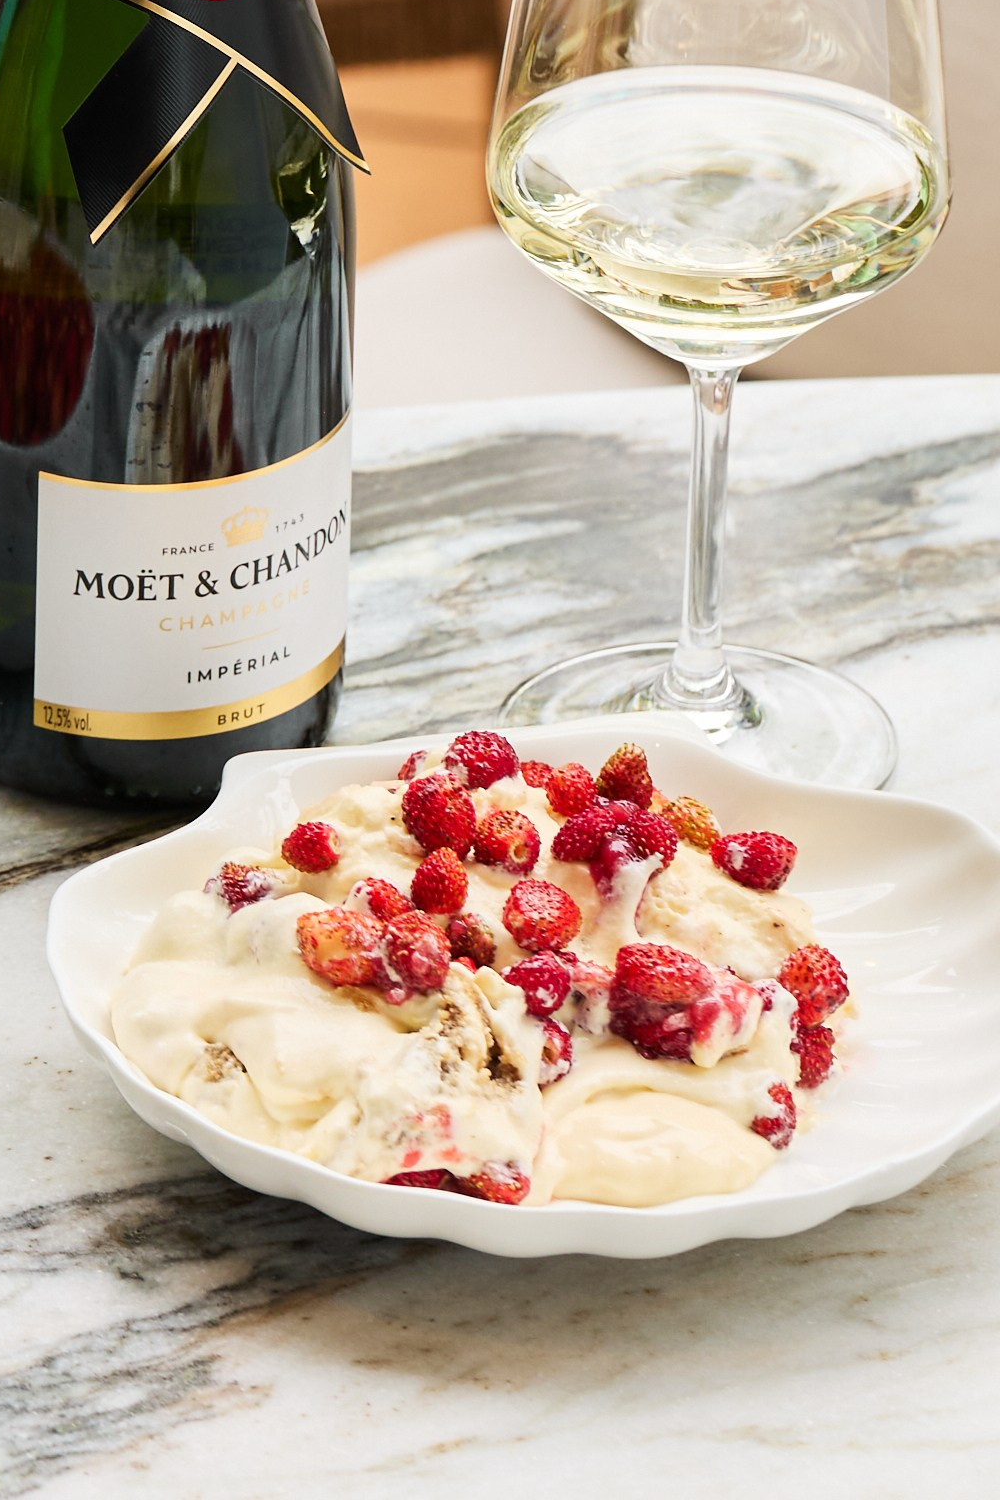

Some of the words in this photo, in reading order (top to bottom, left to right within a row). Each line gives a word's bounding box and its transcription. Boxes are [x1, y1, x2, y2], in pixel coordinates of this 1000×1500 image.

[73, 569, 184, 601] MOËT
[194, 570, 219, 598] &
[230, 500, 347, 590] CHANDON
[162, 542, 215, 556] FRANCE
[158, 579, 310, 632] CHAMPAGNE
[187, 646, 290, 684] IMPÉRIAL
[43, 705, 72, 729] 12,5%
[74, 713, 92, 732] vol.
[217, 703, 266, 725] BRUT
